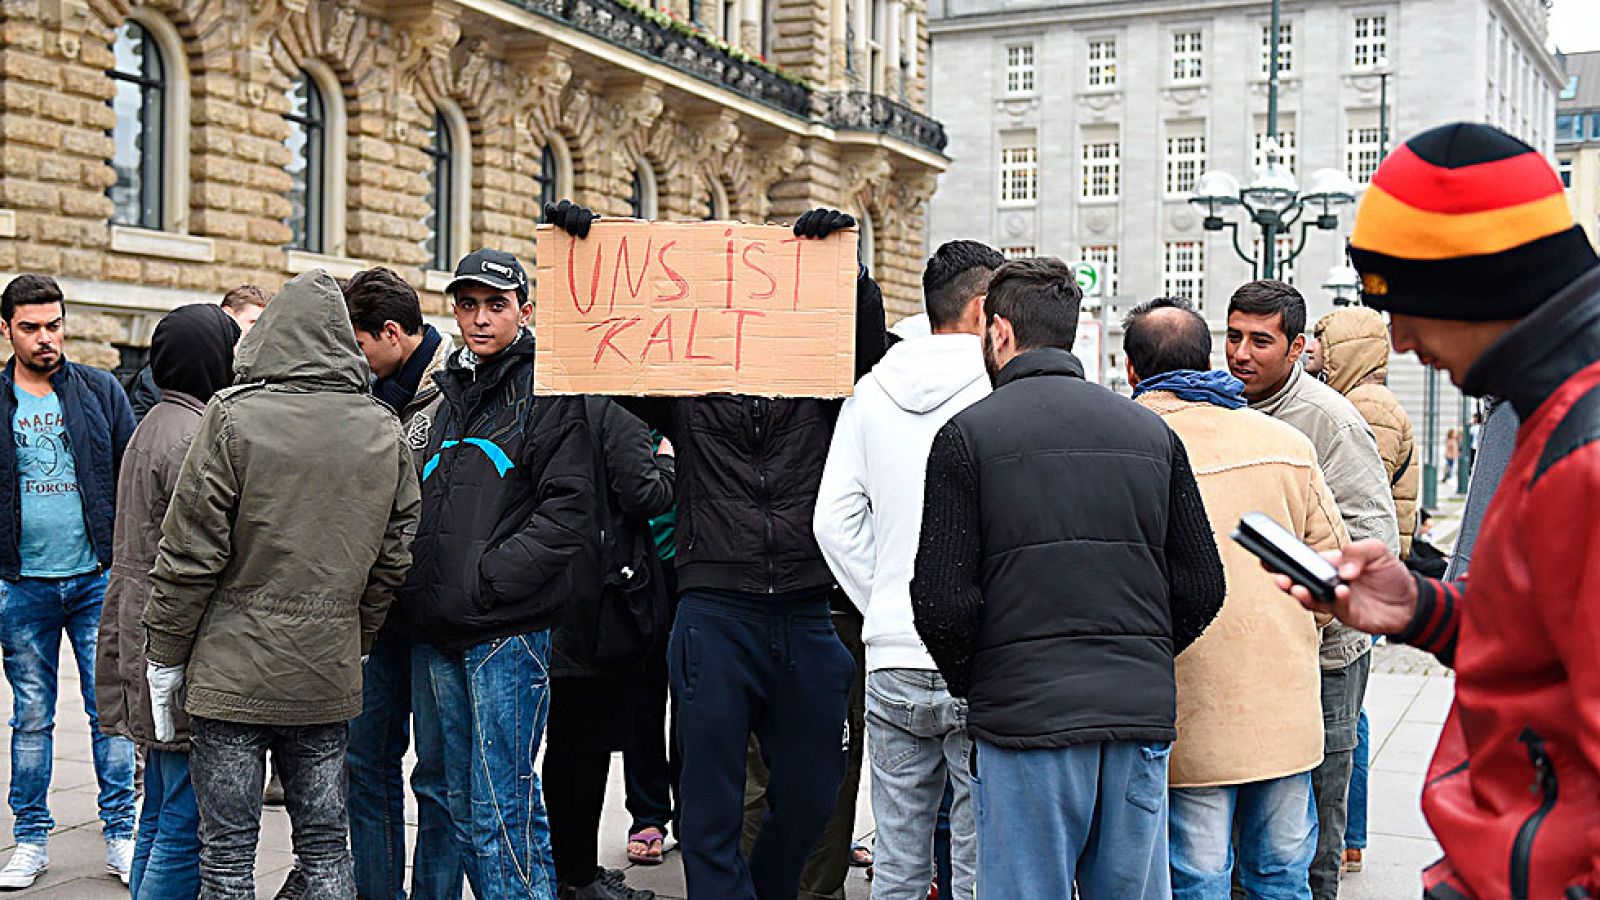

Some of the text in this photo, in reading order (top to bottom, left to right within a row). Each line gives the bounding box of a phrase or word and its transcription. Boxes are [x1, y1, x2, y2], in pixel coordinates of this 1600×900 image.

[567, 235, 690, 314] UNS
[585, 307, 766, 372] KALT
[18, 412, 65, 430] MACH
